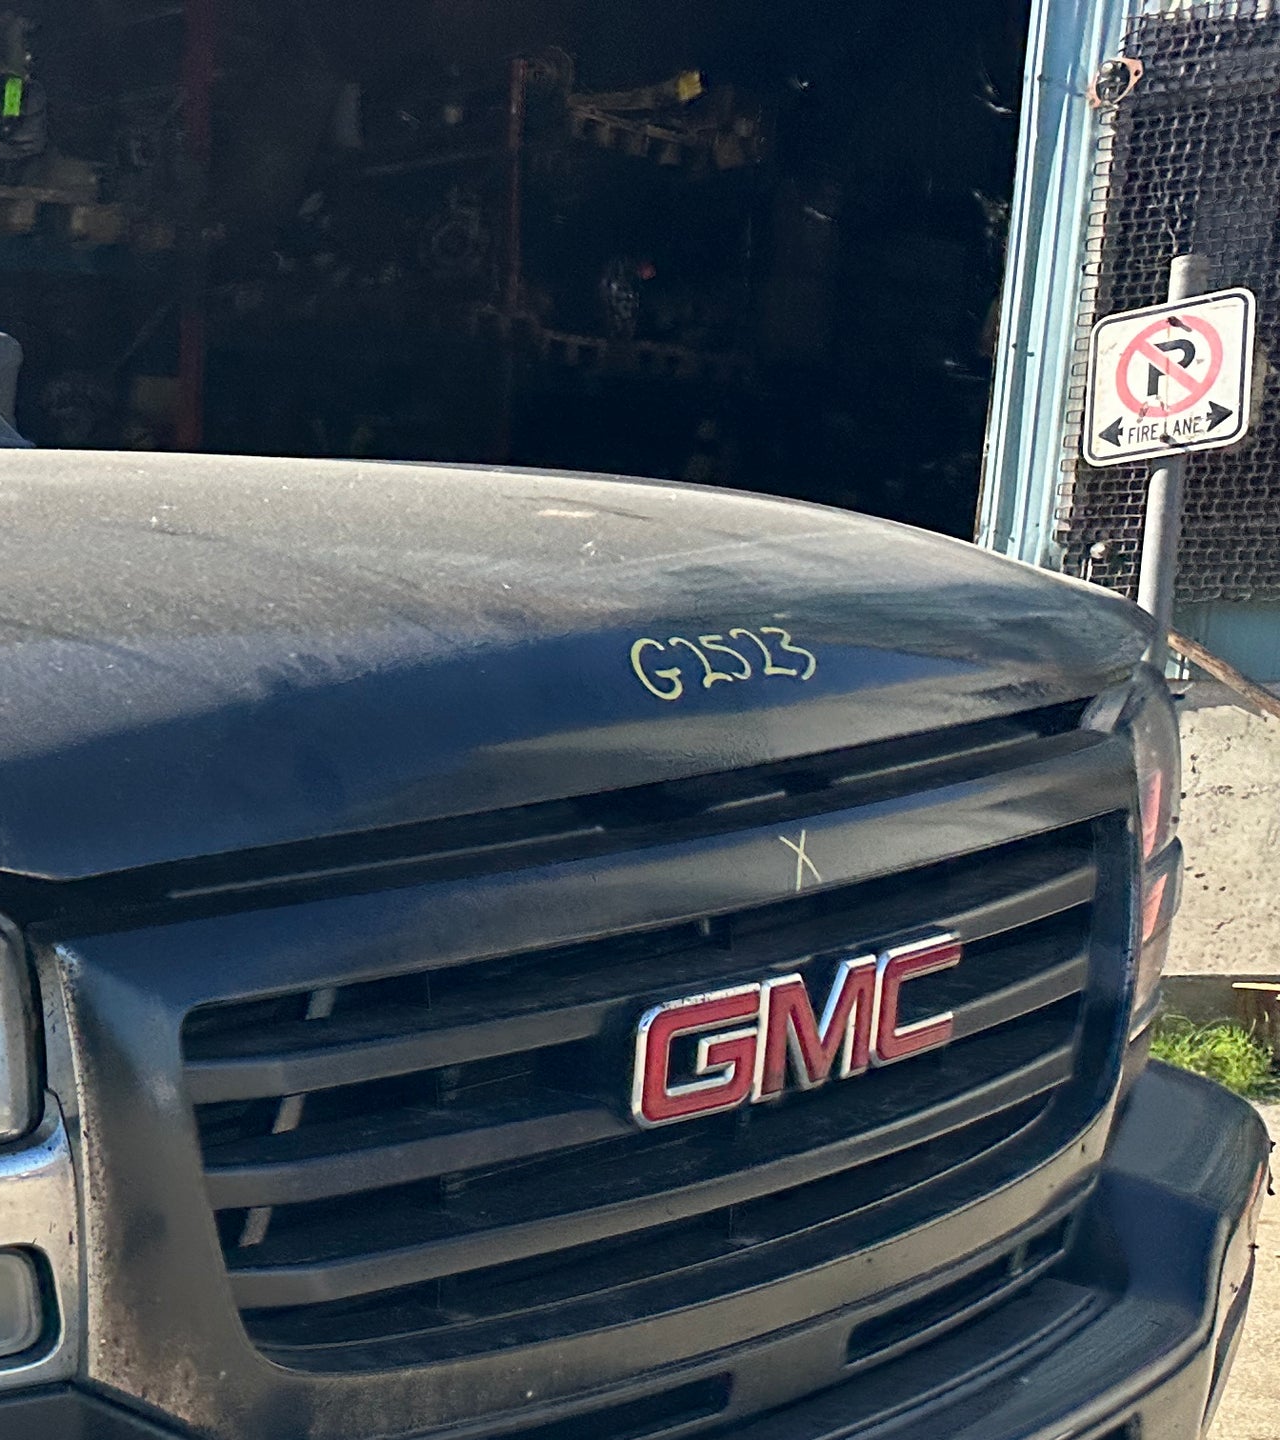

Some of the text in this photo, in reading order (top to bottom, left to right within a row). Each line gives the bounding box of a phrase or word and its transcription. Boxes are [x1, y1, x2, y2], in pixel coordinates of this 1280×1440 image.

[1127, 418, 1202, 444] FIRE LANE
[630, 626, 818, 700] G2523
[631, 931, 963, 1129] GMC
